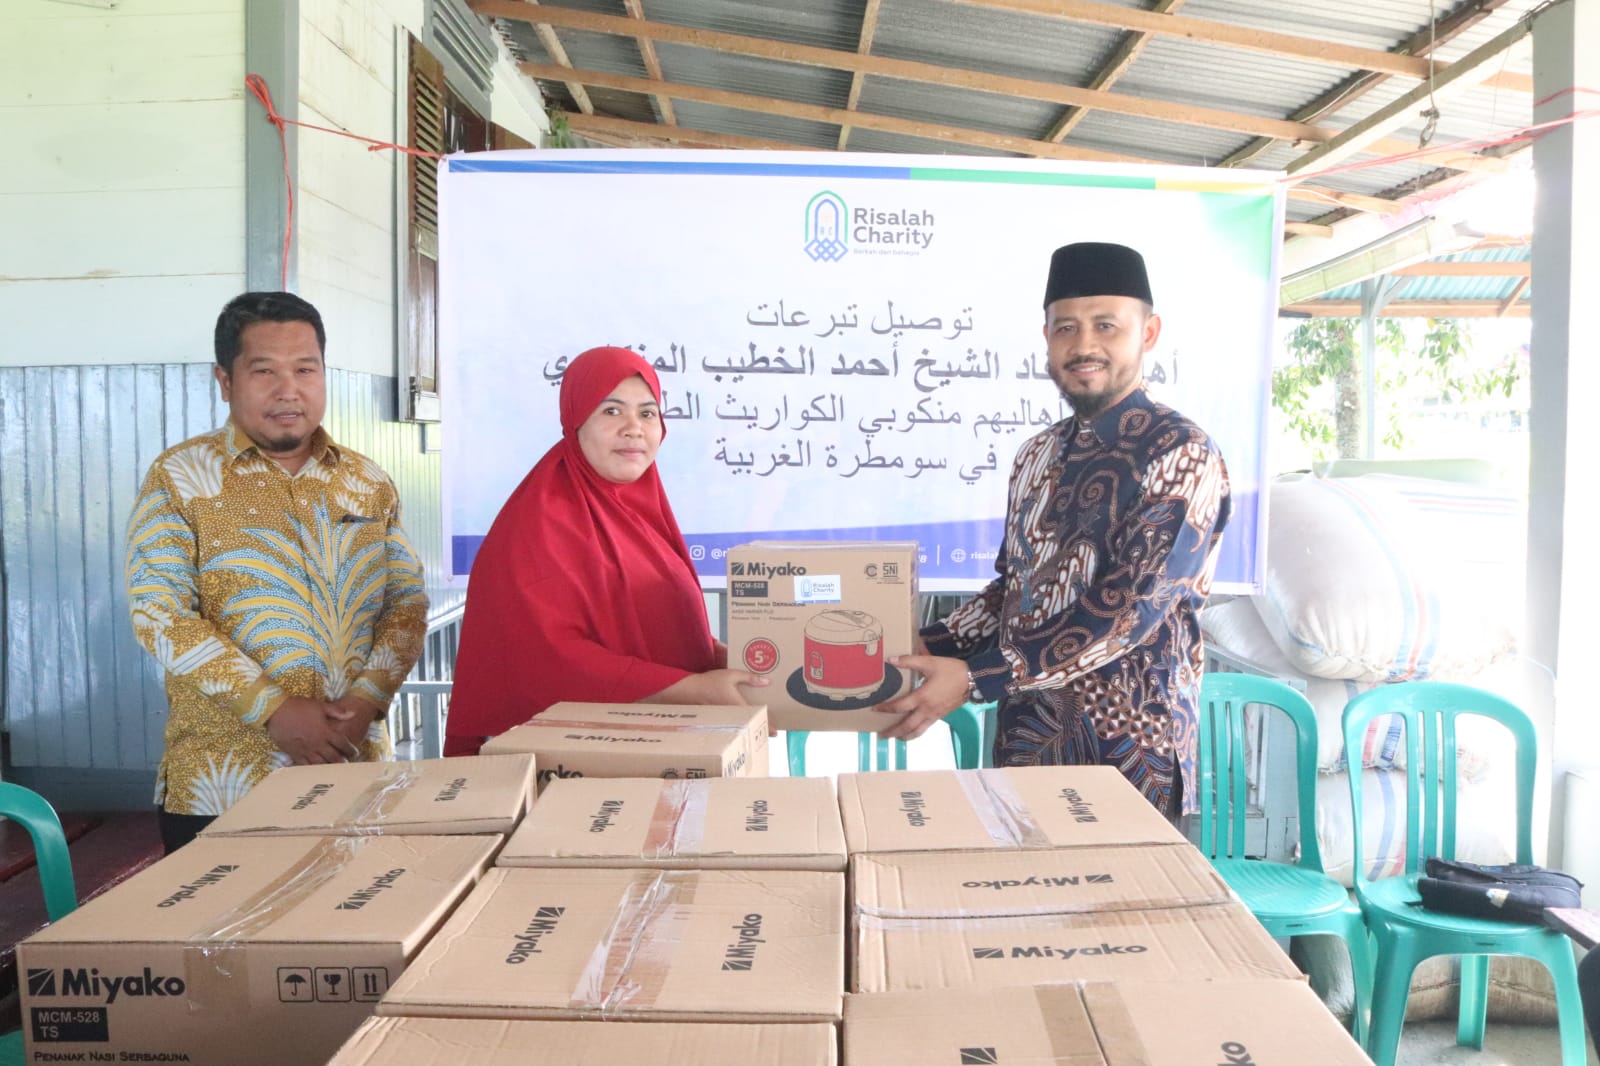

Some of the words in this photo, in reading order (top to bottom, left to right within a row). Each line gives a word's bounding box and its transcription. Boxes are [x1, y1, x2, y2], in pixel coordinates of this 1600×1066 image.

[854, 208, 934, 226] Risalah
[853, 226, 933, 249] Charity
[747, 299, 859, 338] تبرعات
[871, 300, 973, 340] توصيل
[702, 341, 815, 384] الخطيب
[829, 332, 899, 378] أحمد
[914, 349, 999, 393] الشيخ
[715, 393, 844, 431] الكواريث
[858, 397, 961, 438] منكوبي
[714, 438, 811, 476] الغربية
[825, 440, 947, 478] سومطرة
[958, 443, 998, 485] في
[747, 562, 806, 579] Miyako
[584, 735, 662, 743] Miyako
[291, 788, 329, 810] Miyako
[439, 778, 468, 796] Miyako
[1058, 788, 1094, 815] Miyako
[590, 806, 621, 832] Miyako
[745, 800, 776, 824] Miyako
[899, 799, 931, 826] Miyako
[157, 873, 226, 908] Miyako
[353, 868, 406, 902] Miyako
[962, 876, 1079, 890] Miyako
[506, 919, 558, 964] Miyako
[725, 914, 766, 959] Miyako
[1012, 943, 1148, 960] Miyako
[62, 967, 185, 1004] Miyako
[38, 1012, 100, 1023] MCM-528
[40, 1026, 59, 1038] TS
